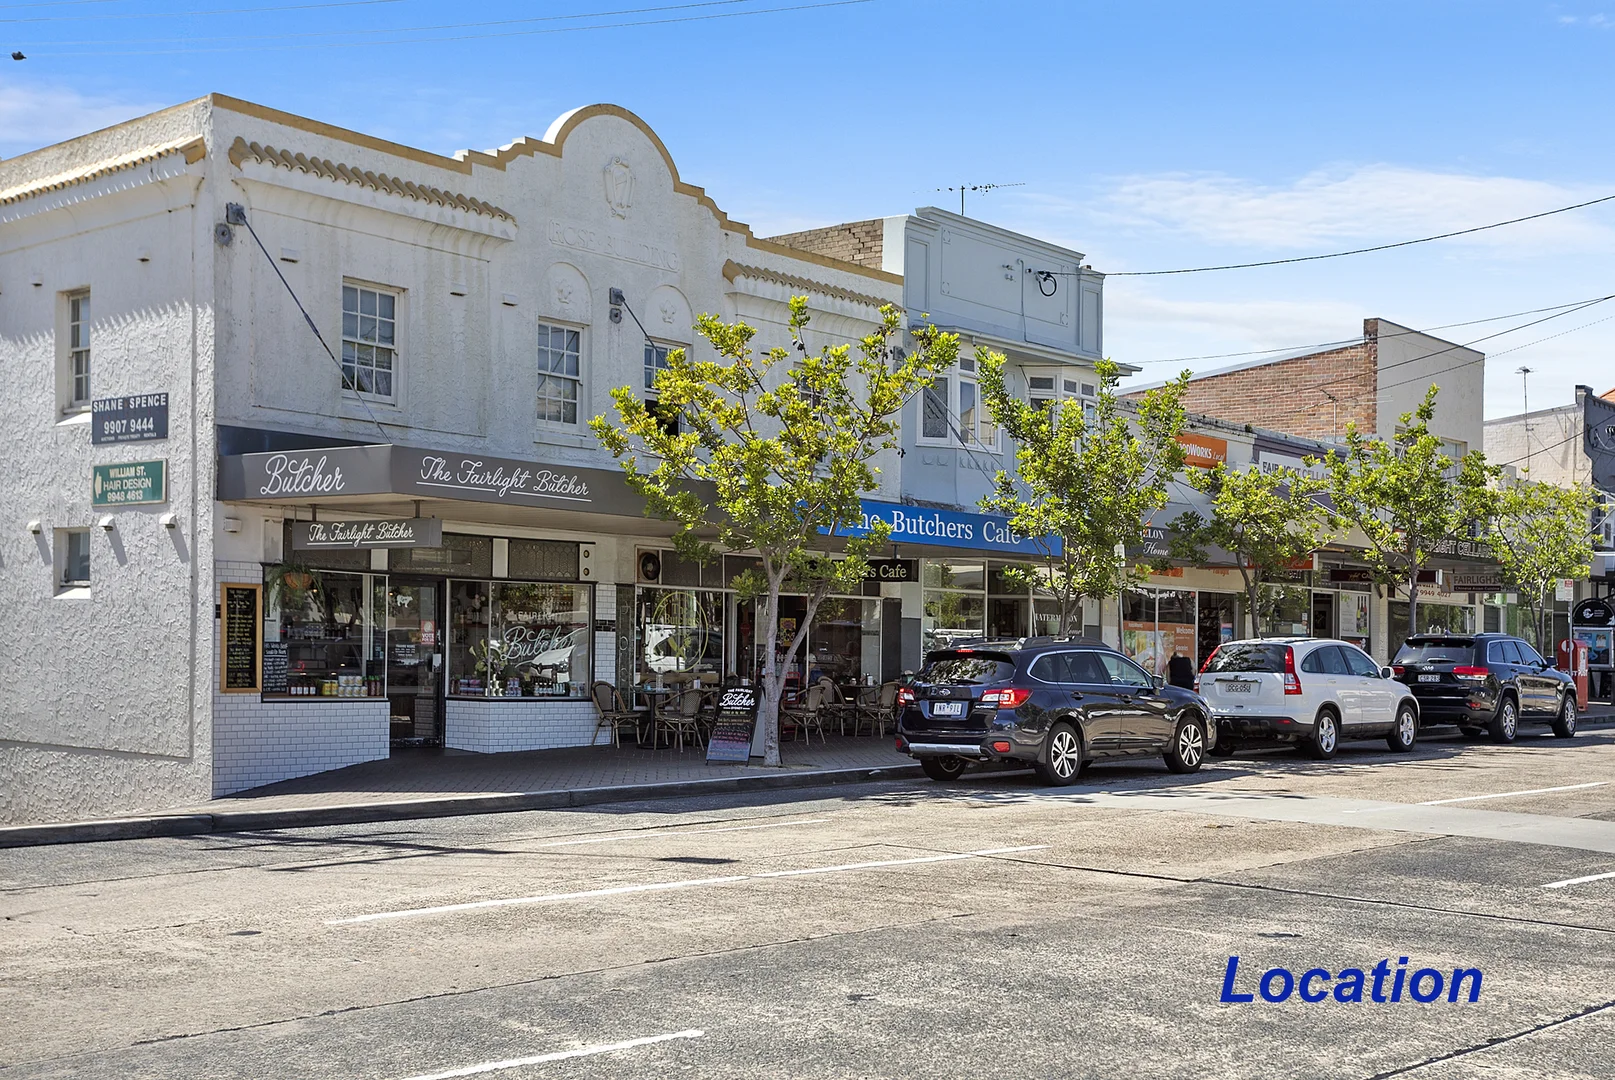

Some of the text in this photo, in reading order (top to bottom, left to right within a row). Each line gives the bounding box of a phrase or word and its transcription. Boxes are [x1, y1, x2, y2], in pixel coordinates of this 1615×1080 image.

[93, 394, 167, 413] SHANE SPENCE
[104, 417, 154, 435] 9907 9444
[109, 465, 147, 479] WILLIAM ST.
[260, 454, 345, 495] Butcher
[420, 456, 589, 497] The Fairlight Butcher
[1262, 461, 1332, 481] FAIRIGHT CELLAR
[103, 478, 152, 491] HAIR DESIGN
[107, 490, 143, 502] 9948 4613
[849, 509, 881, 530] he
[891, 510, 973, 540] Butchers
[309, 521, 414, 547] The Fairlight Butcher
[1143, 541, 1169, 557] Home
[879, 564, 907, 579] Cafe
[1176, 627, 1194, 635] Welcome
[719, 693, 755, 706] Butcher
